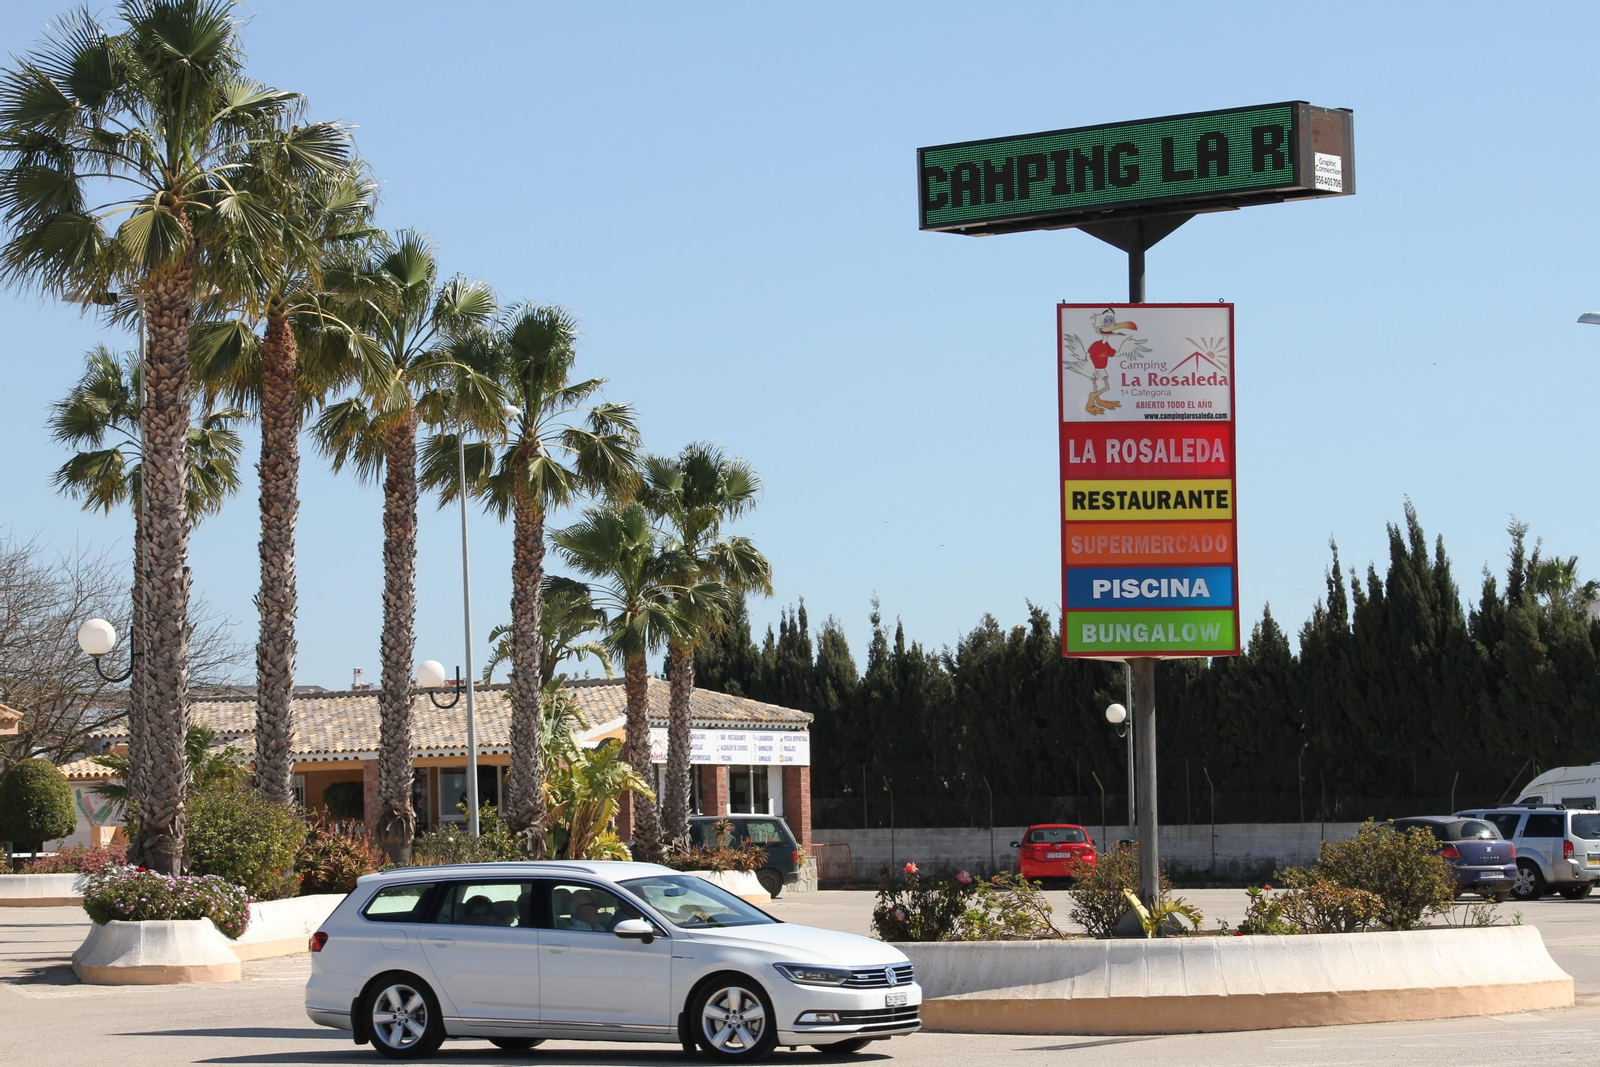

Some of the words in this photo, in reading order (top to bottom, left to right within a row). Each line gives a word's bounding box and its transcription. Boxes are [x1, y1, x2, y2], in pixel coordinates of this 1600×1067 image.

[925, 142, 1139, 211] CAMPING
[1161, 131, 1230, 183] LA
[1252, 124, 1293, 172] R
[1315, 164, 1341, 175] Connection
[1319, 157, 1337, 168] Graphic
[1119, 360, 1168, 372] Camping
[1121, 373, 1141, 387] La
[1148, 372, 1229, 387] Rosaleda
[1135, 400, 1165, 409] ABIERTO
[1166, 400, 1186, 409] TODO
[1188, 400, 1196, 409] EL
[1197, 399, 1213, 409] AÑO
[1144, 412, 1228, 421] www.campinglarosaleda.com
[1068, 439, 1097, 463] LA
[1106, 438, 1226, 463] ROSALEDA
[1072, 490, 1229, 511] RESTAURANTE
[1071, 534, 1228, 554] SUPERMERCADO
[1092, 578, 1210, 599] PISCINA
[1082, 622, 1221, 643] BUNGALOW
